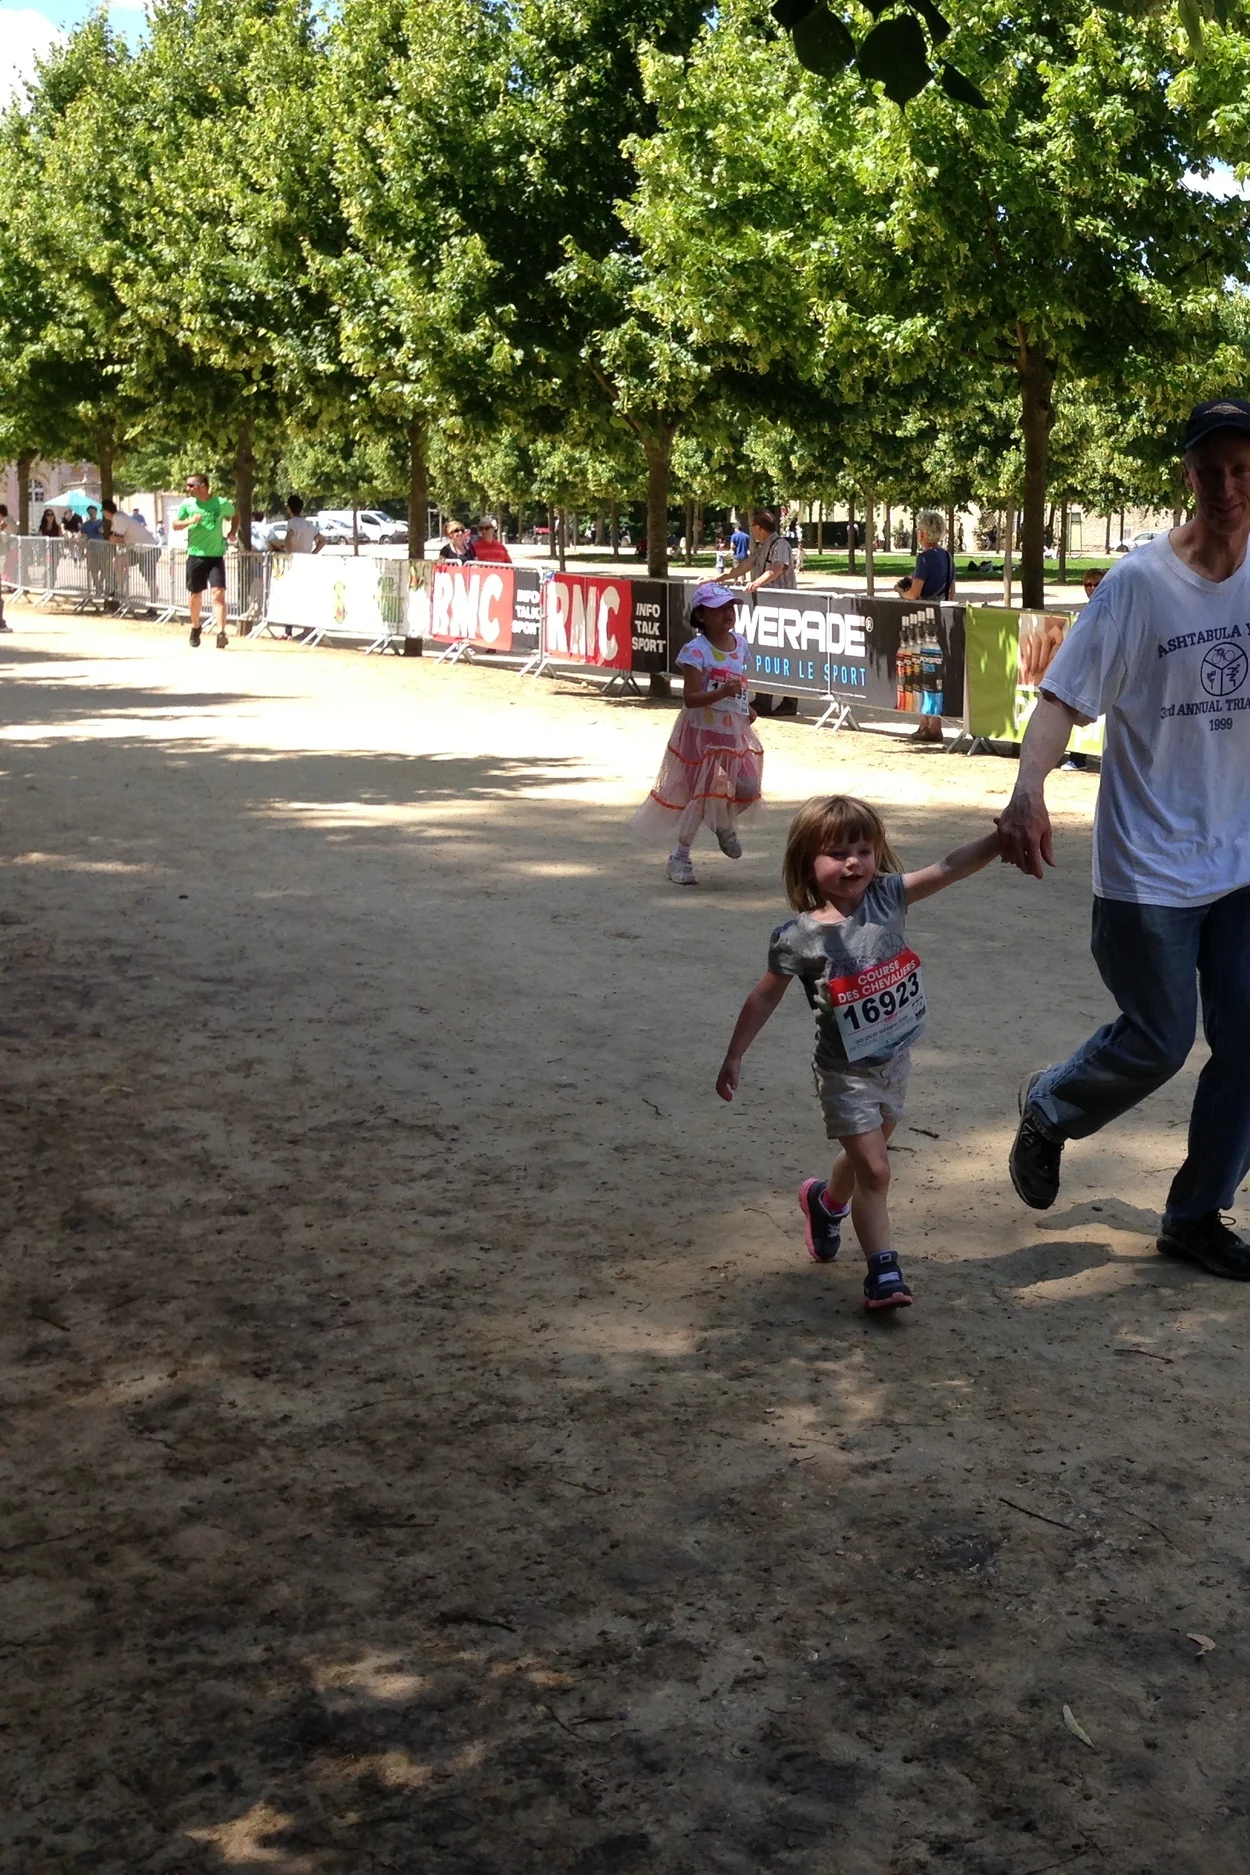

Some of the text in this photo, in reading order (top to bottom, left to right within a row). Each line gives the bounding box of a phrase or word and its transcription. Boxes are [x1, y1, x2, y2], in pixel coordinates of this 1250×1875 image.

[432, 571, 503, 643] RMC
[546, 580, 620, 661] RMC
[636, 602, 661, 619] INFO
[635, 620, 660, 636] TALK
[1157, 624, 1242, 659] ASHTABULA
[632, 636, 666, 654] SPORT
[756, 655, 866, 686] POUR LE SPORT
[1160, 704, 1175, 720] 3rd
[1176, 700, 1222, 717] ANNUAL
[1209, 717, 1233, 732] 1999
[837, 960, 917, 1004] DES CHEVALIERS
[857, 960, 901, 986] COURSE
[843, 972, 919, 1030] 16923
